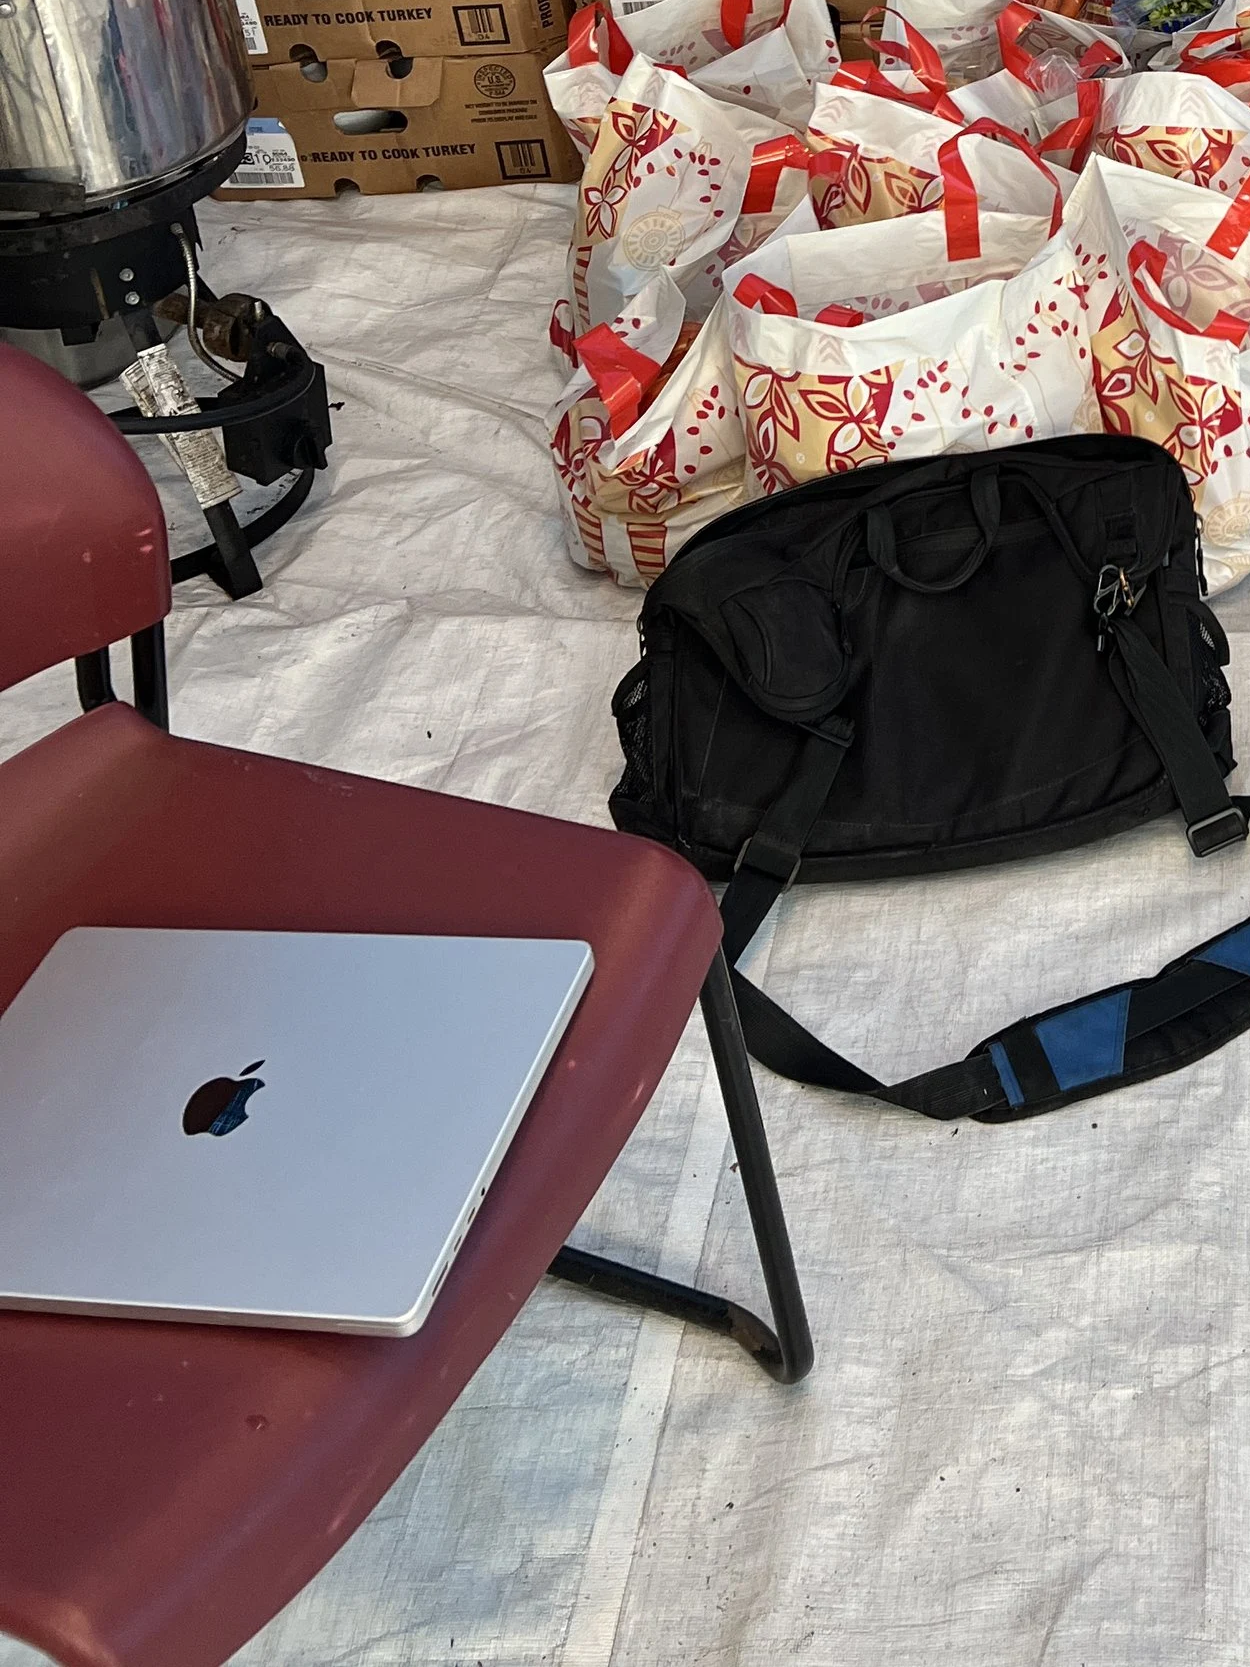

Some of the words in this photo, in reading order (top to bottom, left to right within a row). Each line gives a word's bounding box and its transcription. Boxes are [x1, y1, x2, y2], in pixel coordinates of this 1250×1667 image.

[264, 13, 308, 27] READY
[312, 13, 331, 25] TO
[335, 11, 375, 24] COOK
[377, 8, 432, 21] TURKEY
[487, 75, 503, 84] U.S.
[312, 151, 355, 163] READY
[359, 149, 378, 161] TO
[382, 148, 420, 159] COOK
[422, 143, 476, 158] TURKEY
